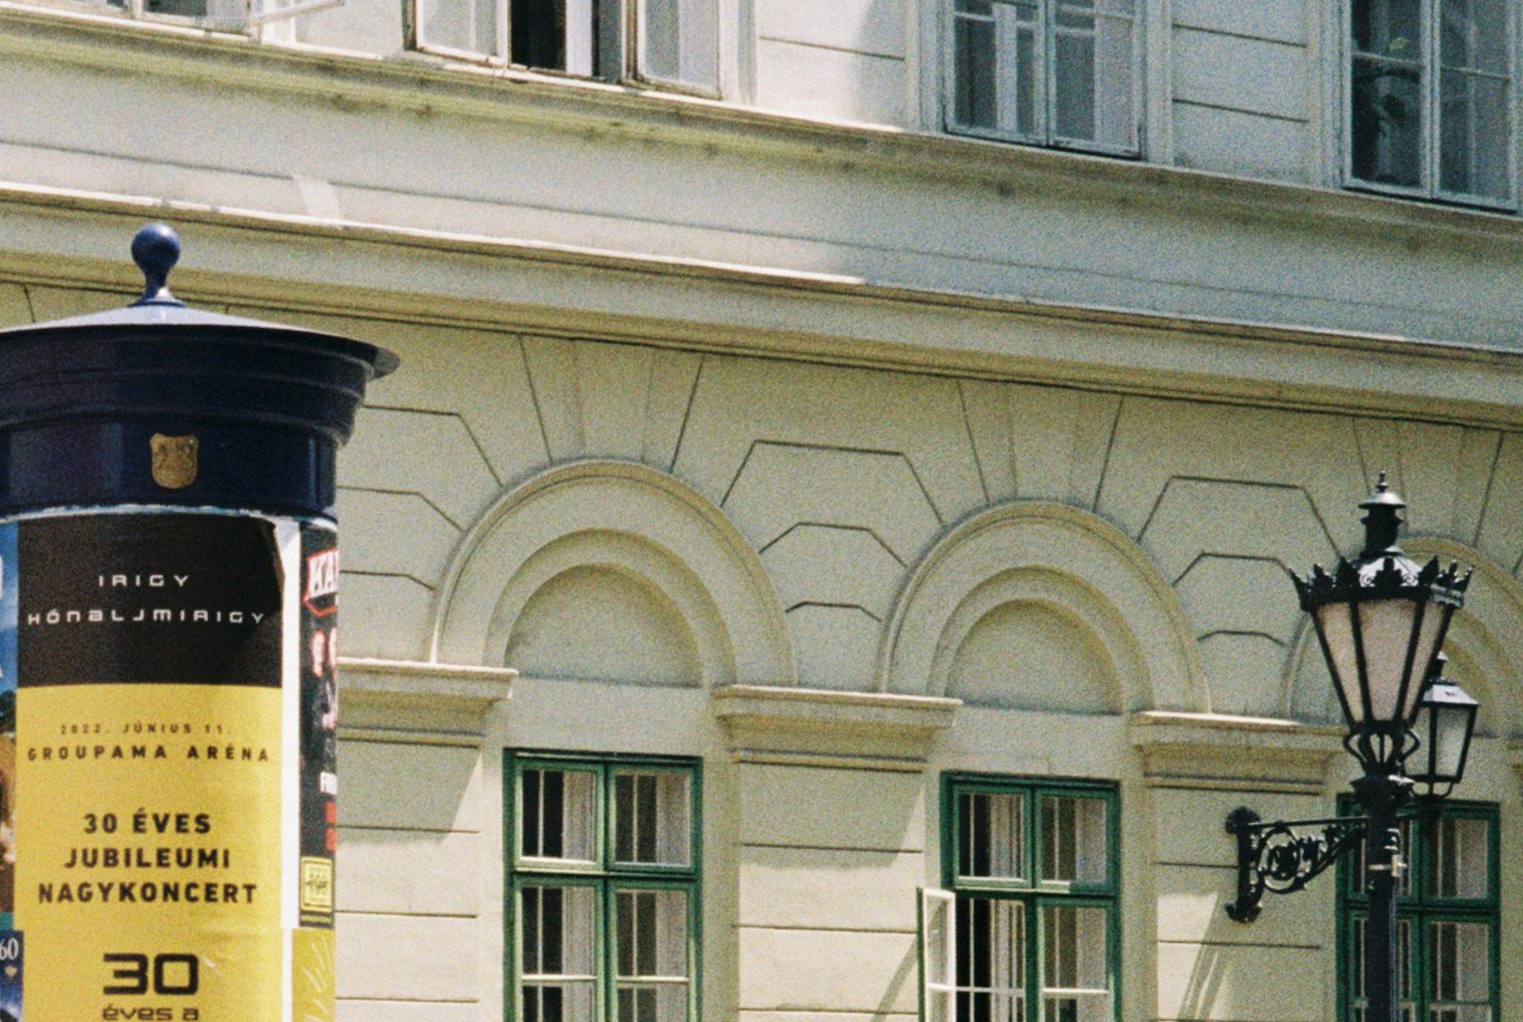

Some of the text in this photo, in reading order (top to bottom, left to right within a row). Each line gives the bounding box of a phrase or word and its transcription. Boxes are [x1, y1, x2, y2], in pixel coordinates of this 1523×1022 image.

[98, 574, 189, 588] IRIGY
[27, 742, 269, 763] GROUPAMA ARÉNA
[83, 807, 212, 834] 30 ÉVES
[64, 848, 231, 869] JUBILEUMI
[38, 882, 258, 904] NAGYKONCERT
[102, 953, 200, 996] 30
[102, 1006, 200, 1022] éves a
